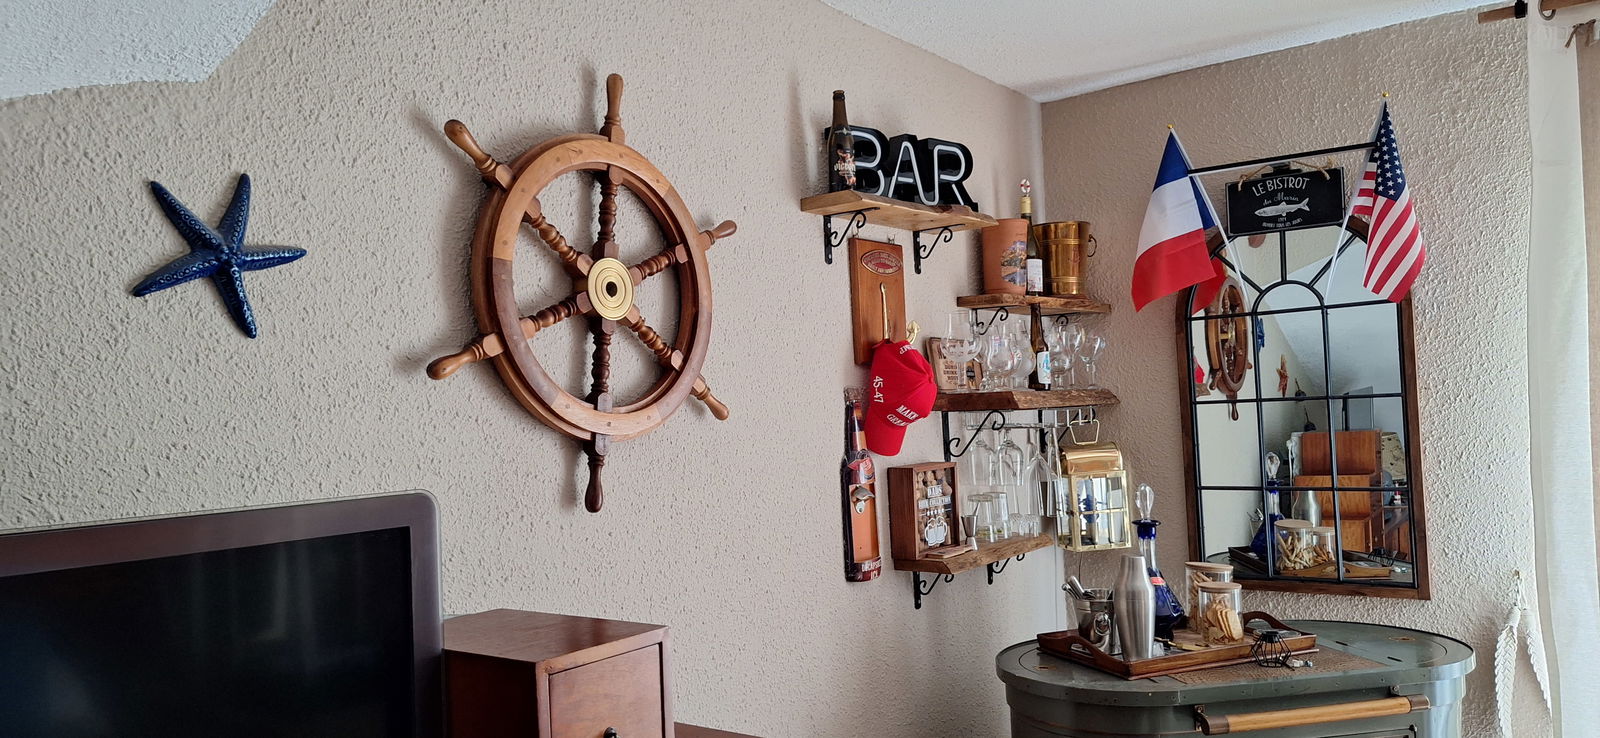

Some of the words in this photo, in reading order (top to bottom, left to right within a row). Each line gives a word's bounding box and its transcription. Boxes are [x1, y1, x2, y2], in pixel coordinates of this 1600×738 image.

[848, 127, 974, 207] BAR
[1252, 183, 1266, 197] LE
[1267, 176, 1311, 192] BISTROT
[873, 375, 884, 403] 45-47
[896, 405, 919, 420] MAKE
